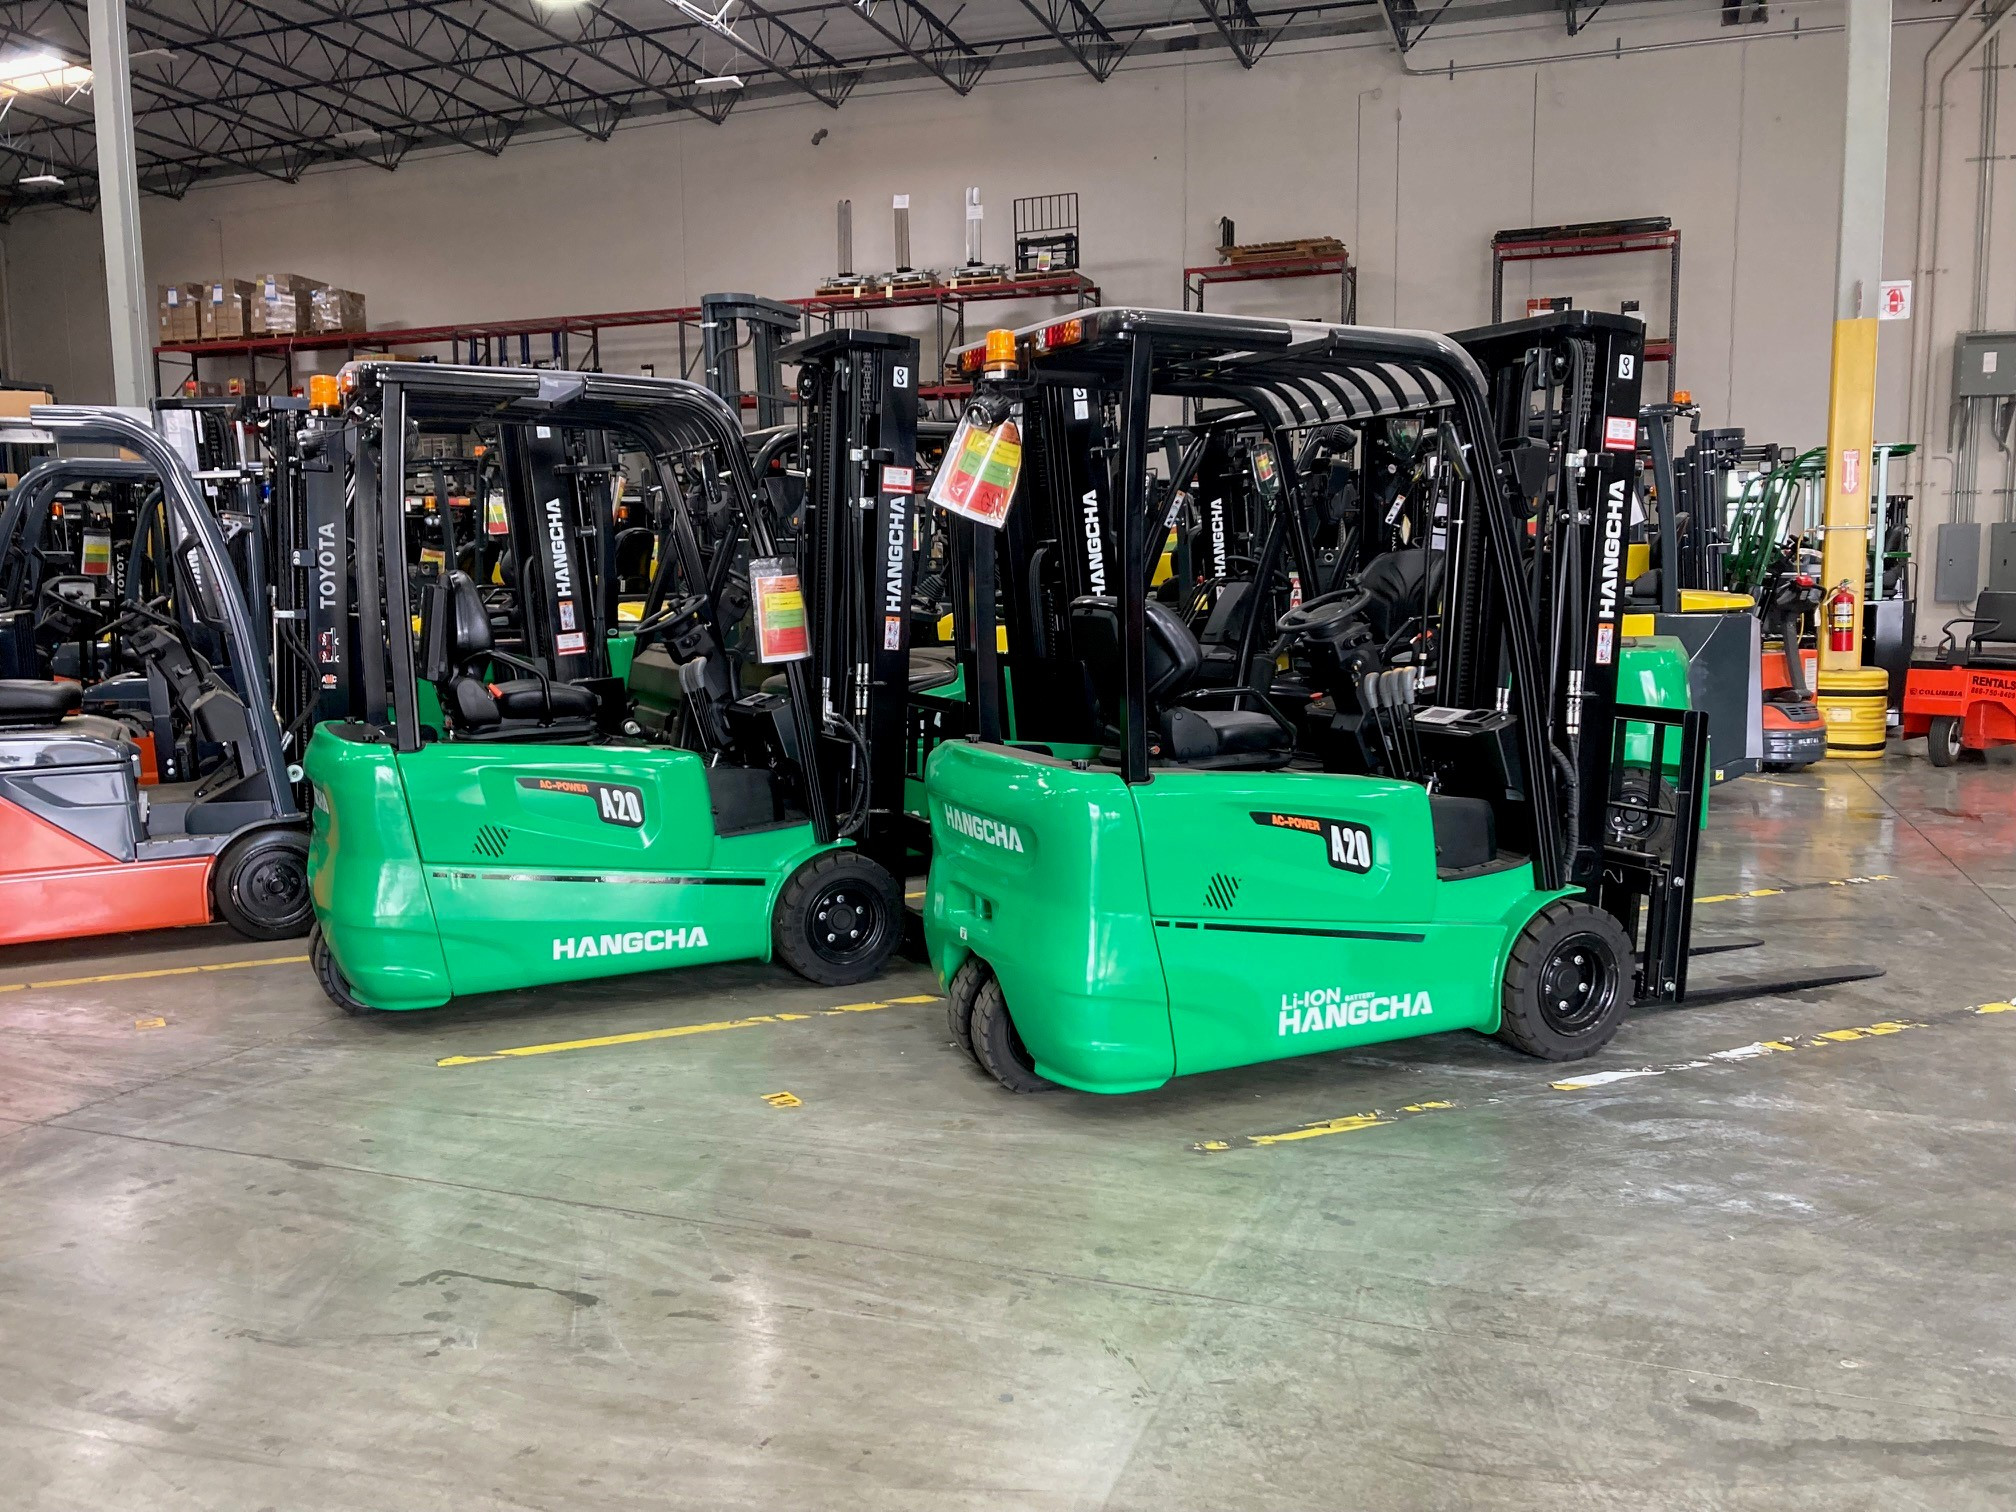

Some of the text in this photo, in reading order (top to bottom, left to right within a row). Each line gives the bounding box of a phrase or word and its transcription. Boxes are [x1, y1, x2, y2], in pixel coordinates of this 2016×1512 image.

[545, 498, 572, 597] HANGCHA
[886, 496, 906, 612] HANGCHA
[1082, 489, 1107, 599] HANGCHA
[1210, 498, 1227, 578] HANGCHA
[1598, 479, 1626, 618] HANGCHA
[116, 552, 125, 596] TOYOT
[318, 522, 336, 610] TOYOTA
[1918, 689, 1963, 697] COLUMBIA
[1972, 675, 2016, 691] RENTALS
[540, 780, 589, 793] AC-POWER
[600, 787, 642, 823] A20
[944, 803, 1024, 853] HANGCHA
[1271, 814, 1320, 831] AC-POWER
[1330, 824, 1371, 868] A20
[552, 926, 709, 960] HANGCHA
[1278, 990, 1433, 1036] HANGCHA
